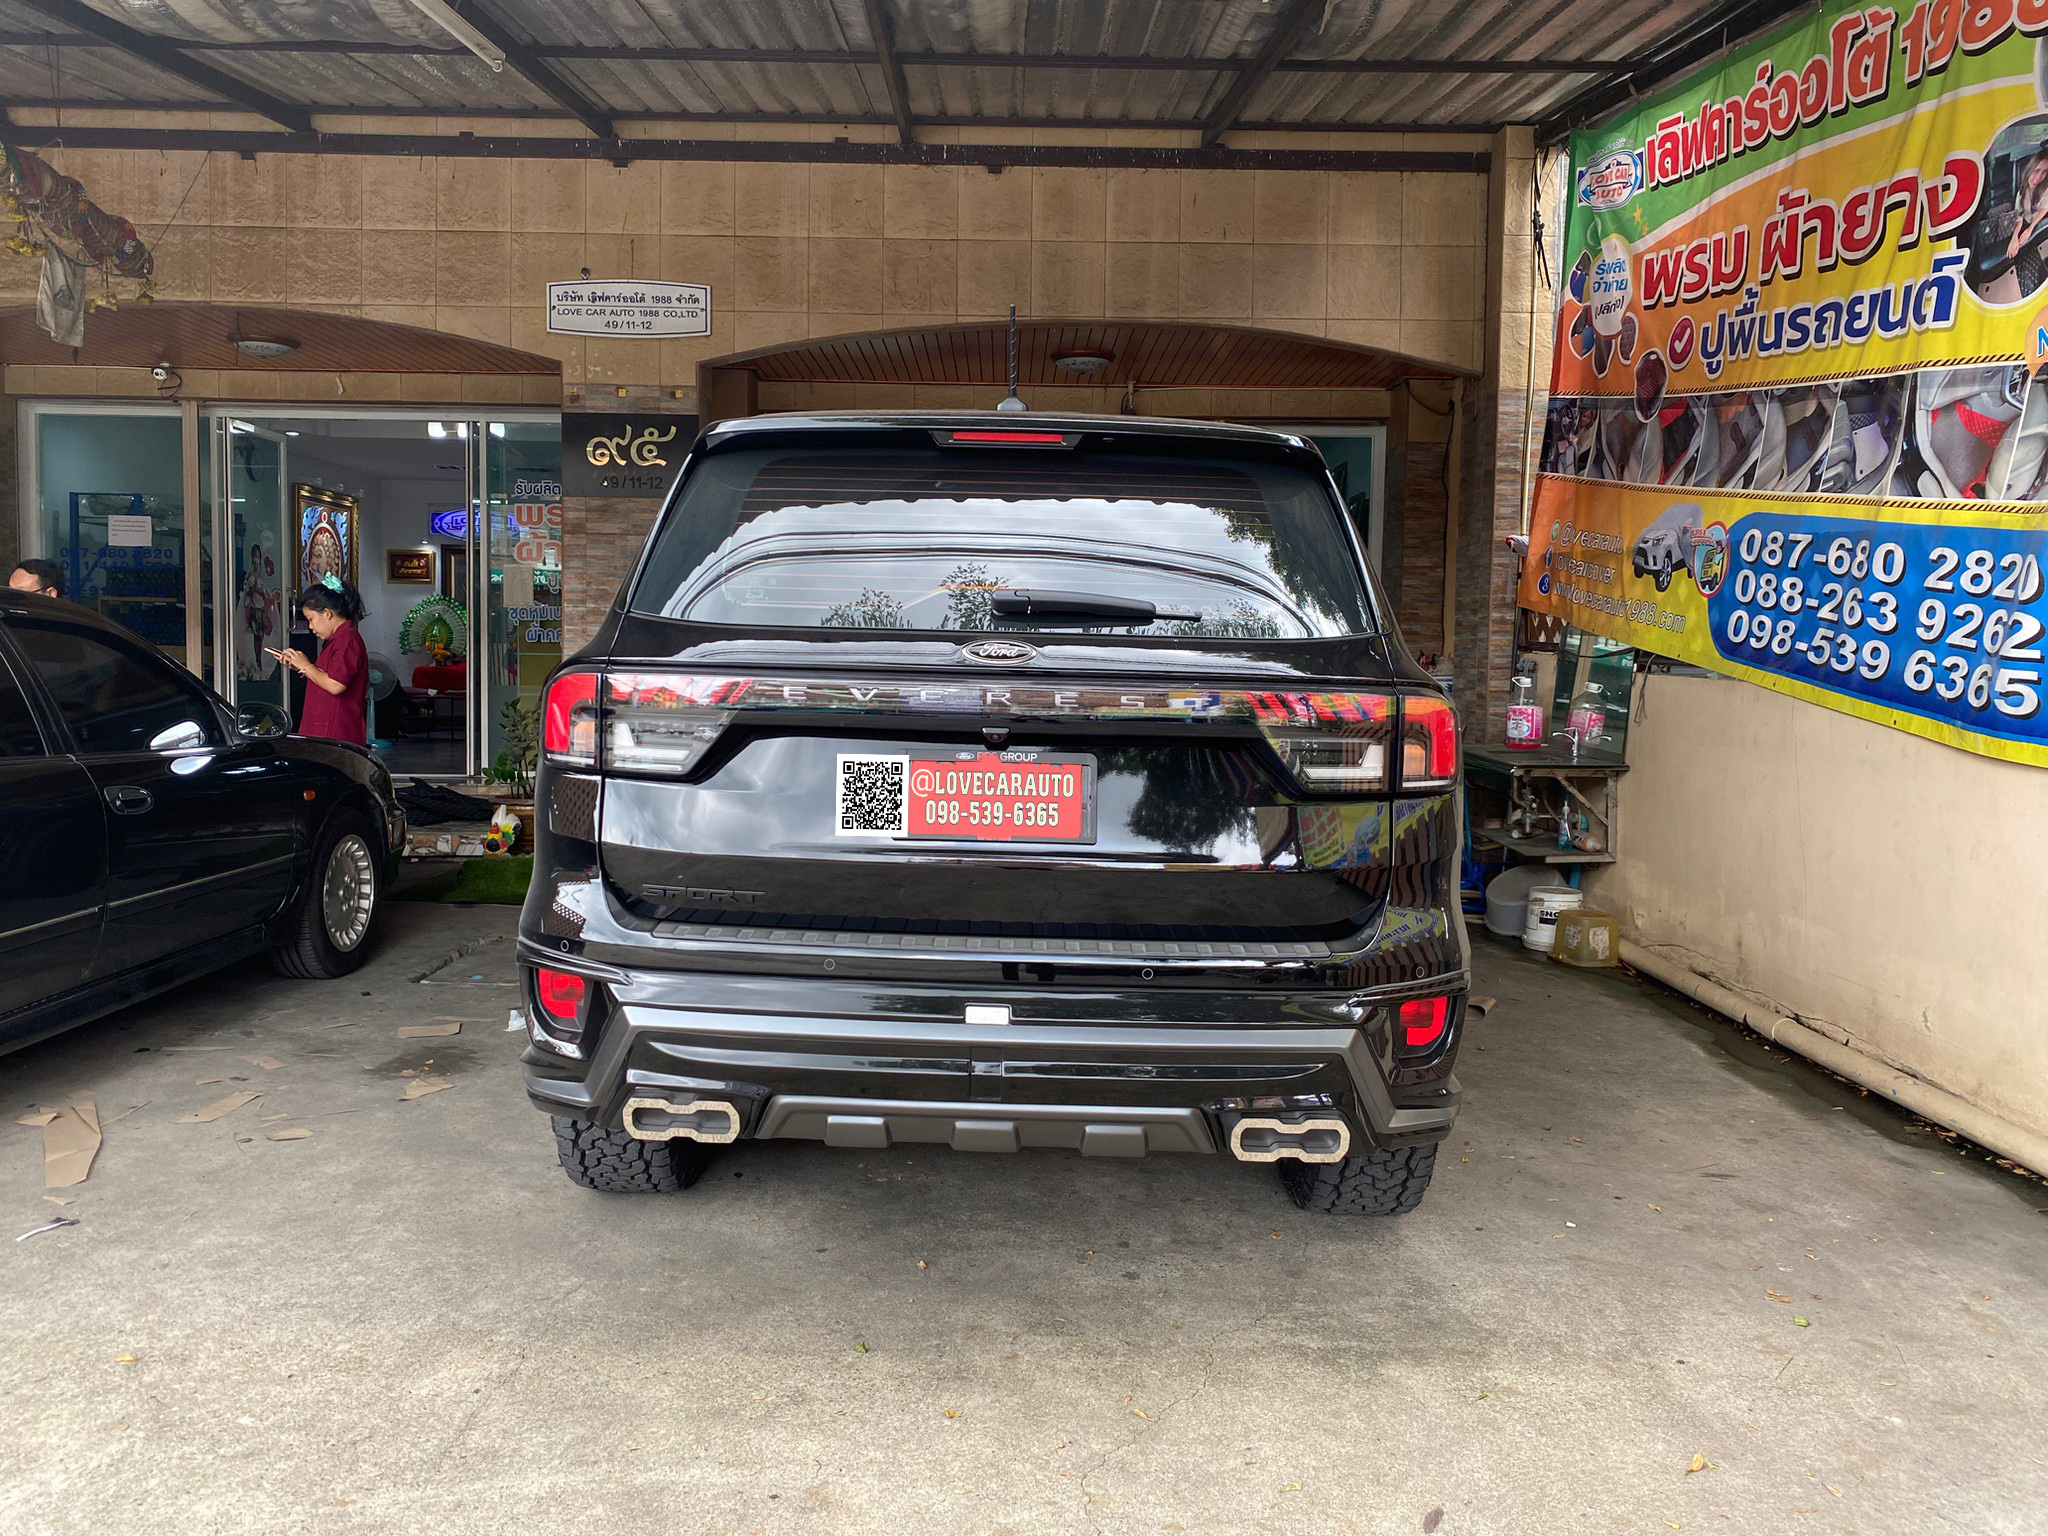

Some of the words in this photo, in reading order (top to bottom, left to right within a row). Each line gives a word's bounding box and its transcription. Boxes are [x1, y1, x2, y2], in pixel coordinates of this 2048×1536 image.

[1645, 5, 1897, 188] เลิฟคาร์ออโต้
[1642, 225, 1749, 307] พรม
[1760, 151, 1984, 284] ผ้ายาง
[557, 291, 584, 302] บริษัท
[651, 296, 672, 304] 1988
[676, 294, 700, 305] จำกัด
[586, 309, 606, 317] CAR
[639, 310, 660, 318] 1988
[1700, 249, 1971, 379] ปูพื้นรถยนต์
[515, 480, 562, 495] รับผลิต
[1740, 528, 1905, 584] 087-680
[1923, 547, 2042, 601] 2820
[1735, 569, 1898, 632] 088-263
[1915, 598, 2043, 660] 9262
[979, 642, 1019, 659] Ford
[1727, 609, 1891, 680] 098-539
[1903, 649, 2040, 717] 6365
[783, 686, 1213, 712] EVEREST
[1000, 751, 1038, 762] GROUP
